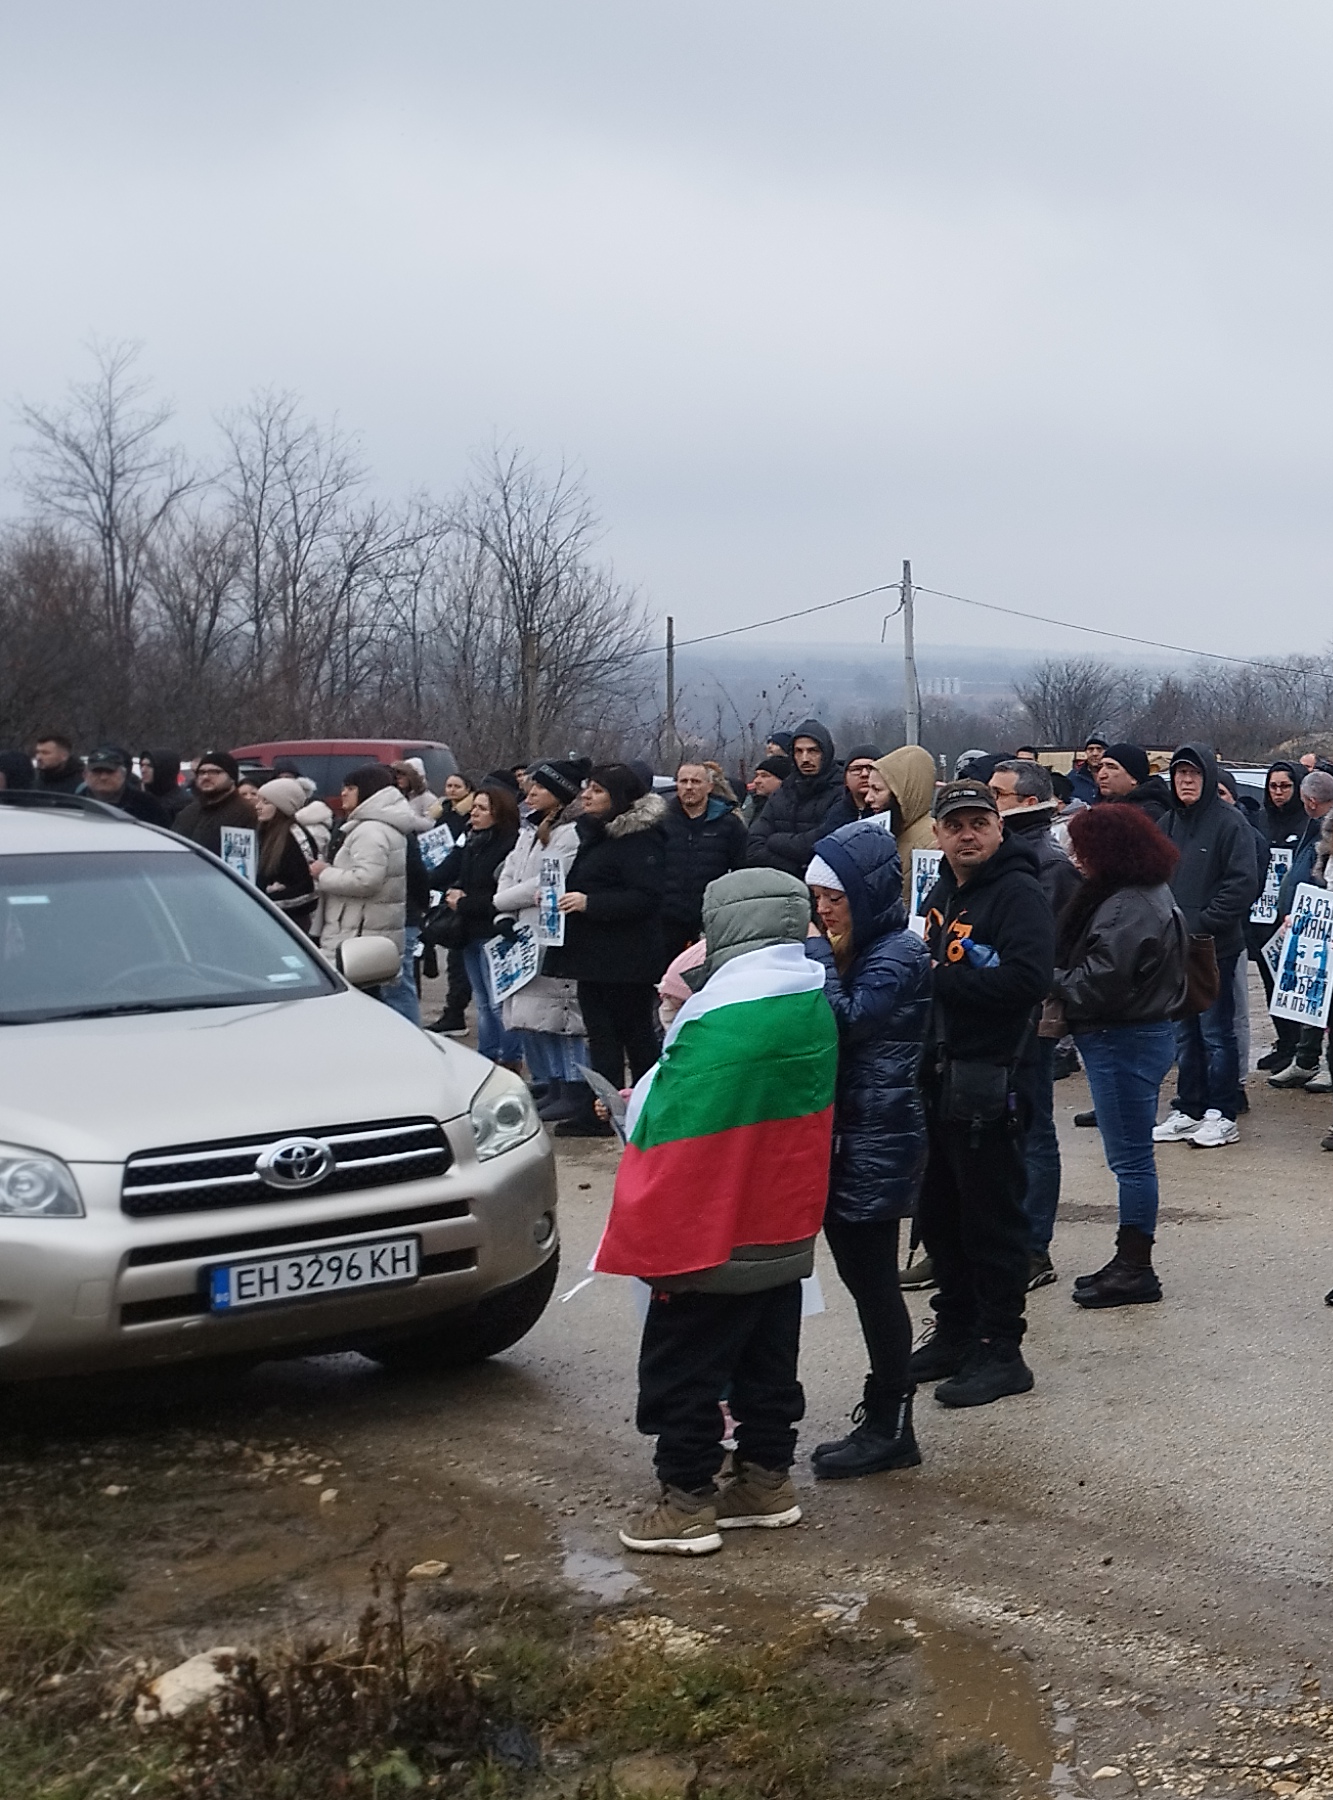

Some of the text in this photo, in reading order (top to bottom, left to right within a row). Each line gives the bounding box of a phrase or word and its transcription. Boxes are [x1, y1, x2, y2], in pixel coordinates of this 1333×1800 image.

[1295, 894, 1312, 914] АЗ
[1275, 992, 1288, 1008] НА
[286, 1252, 363, 1292] 3296
